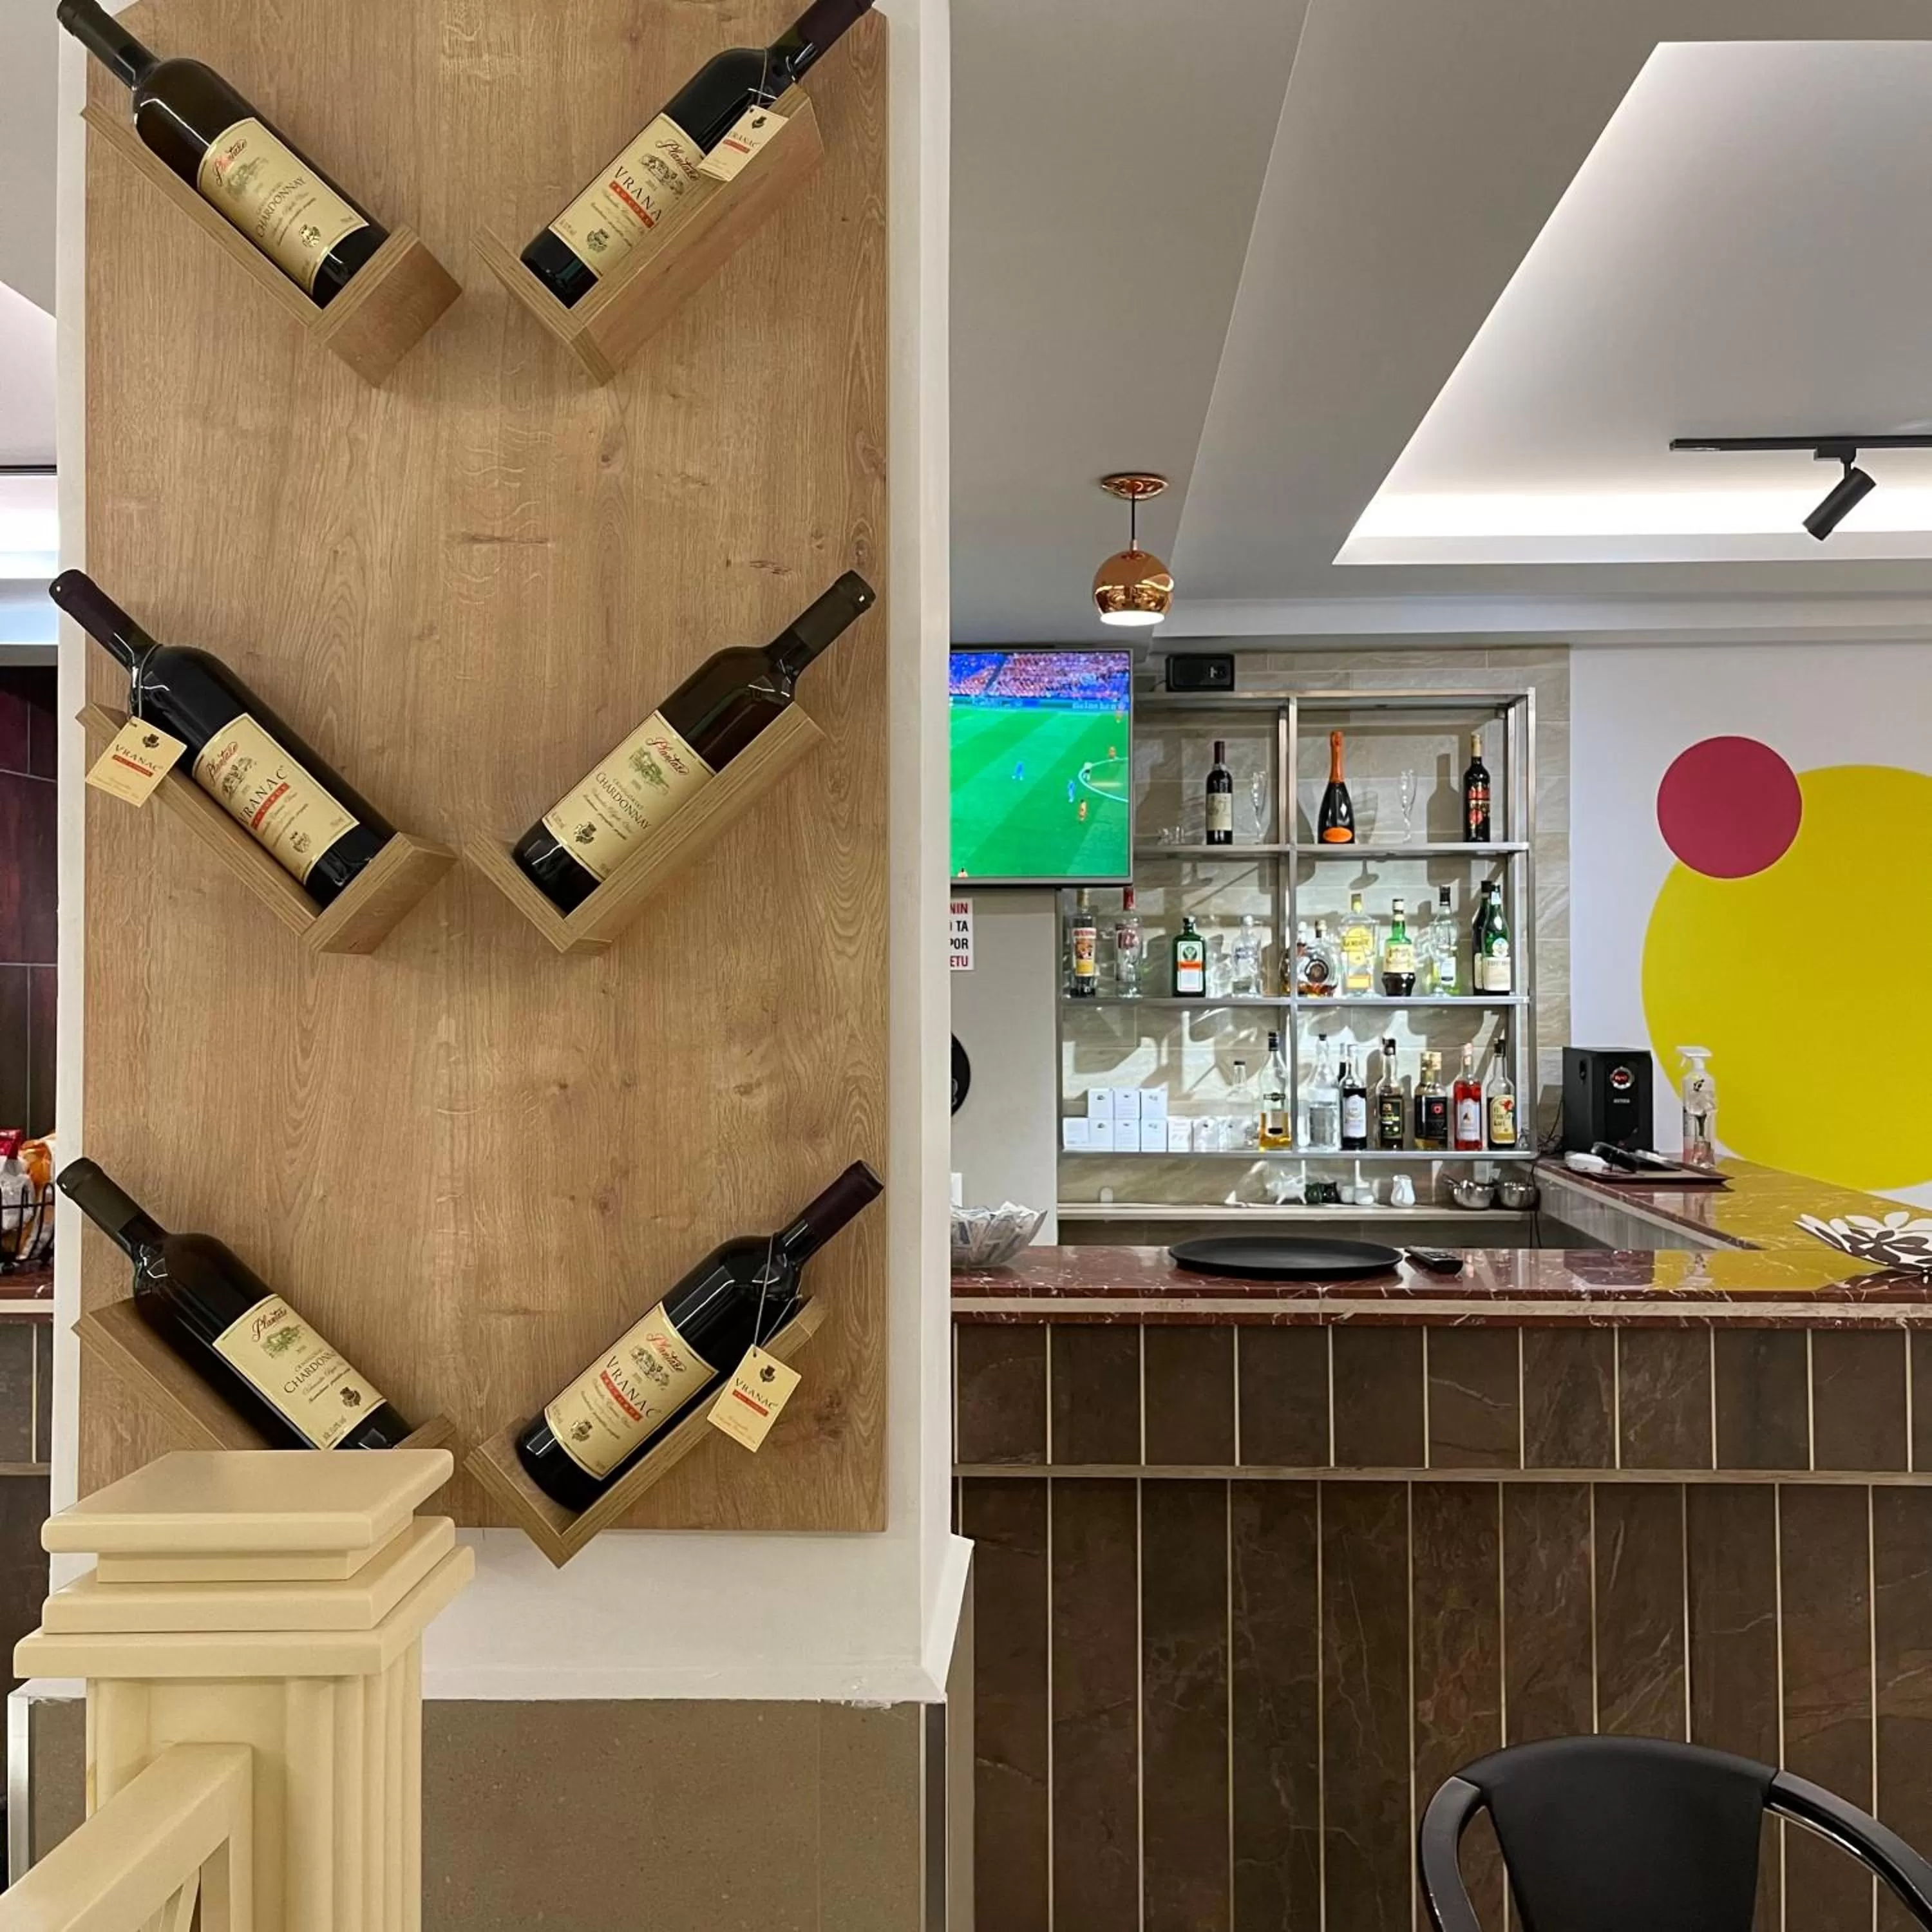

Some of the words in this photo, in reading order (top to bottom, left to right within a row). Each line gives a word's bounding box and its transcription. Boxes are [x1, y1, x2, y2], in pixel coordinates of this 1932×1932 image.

[255, 176, 307, 238] CHARDONNAY
[114, 744, 160, 772] VRANAC
[596, 772, 652, 829] CHARDONNAY
[956, 920, 969, 933] TA
[605, 1356, 661, 1417] VRANAC
[735, 1378, 777, 1408] VRANAC
